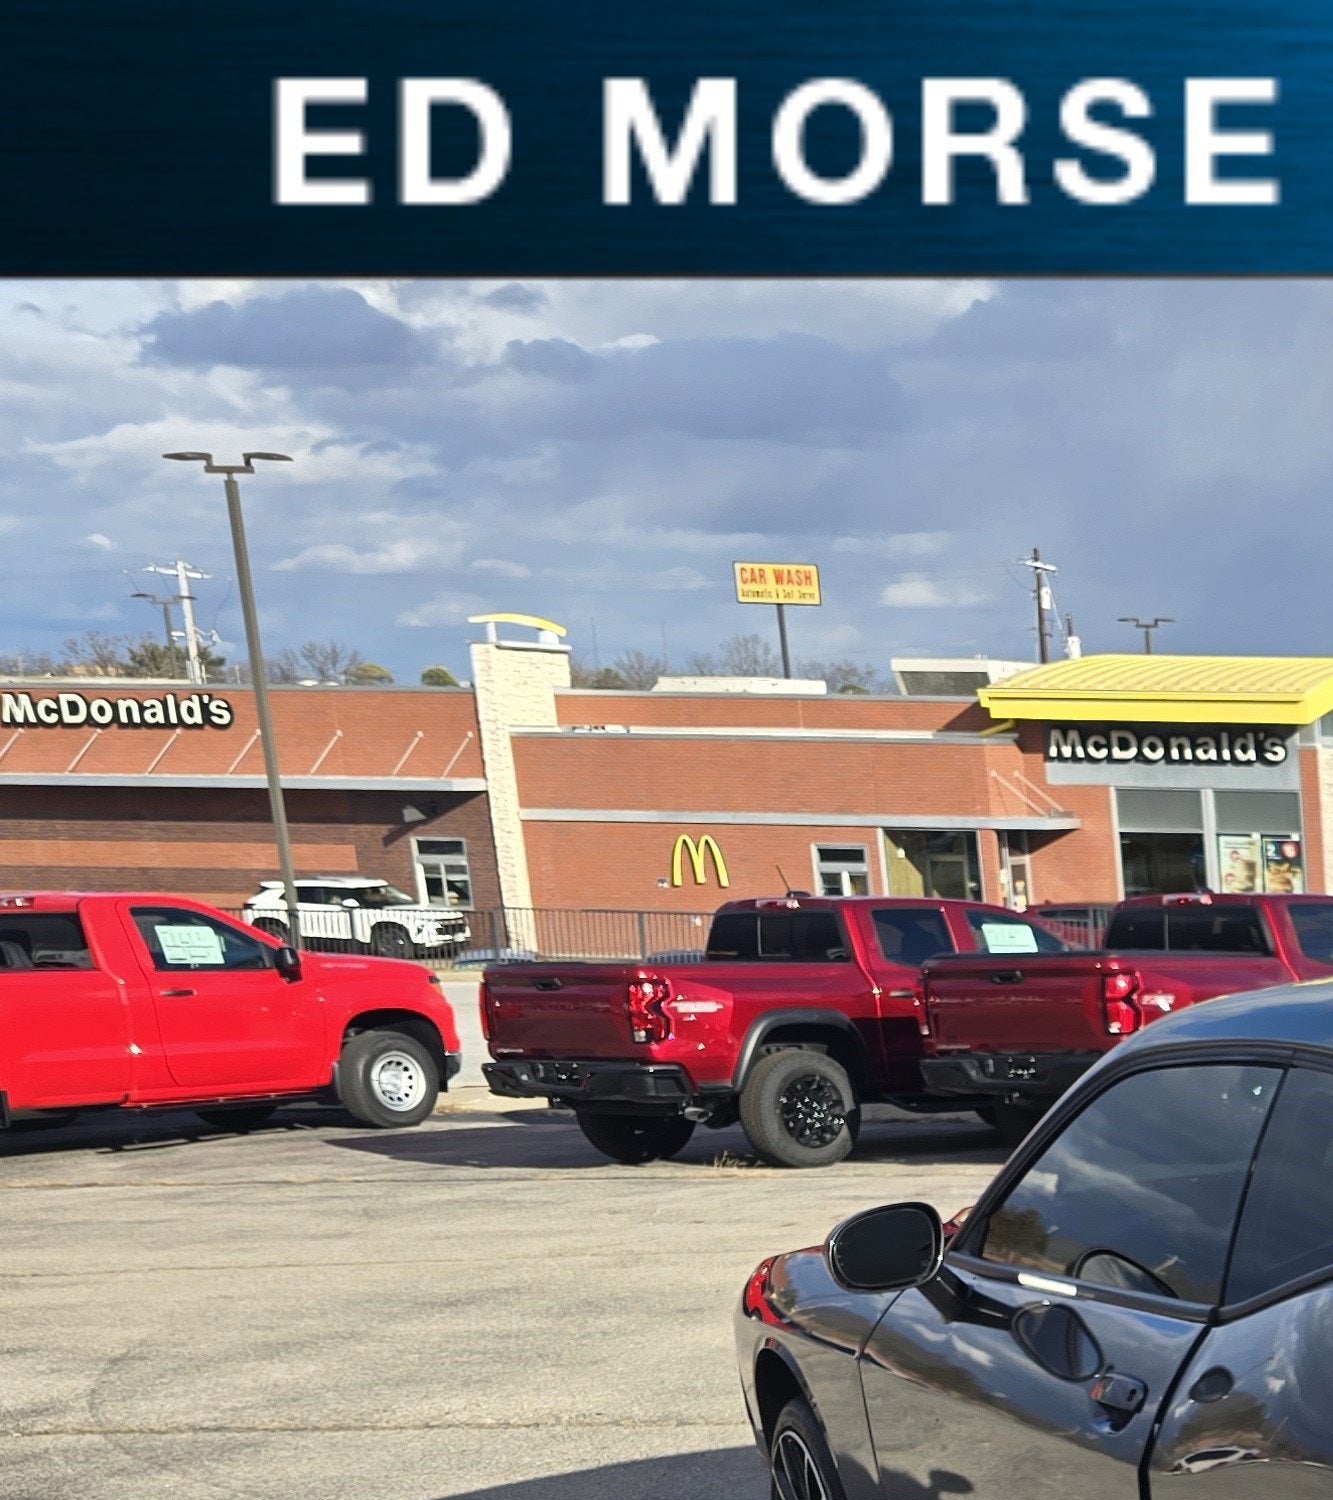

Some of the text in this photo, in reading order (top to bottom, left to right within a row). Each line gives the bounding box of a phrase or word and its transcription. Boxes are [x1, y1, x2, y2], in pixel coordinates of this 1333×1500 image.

[740, 567, 812, 586] CAR WASH
[1, 693, 233, 725] McDonald's
[1049, 729, 1286, 762] McDonald's
